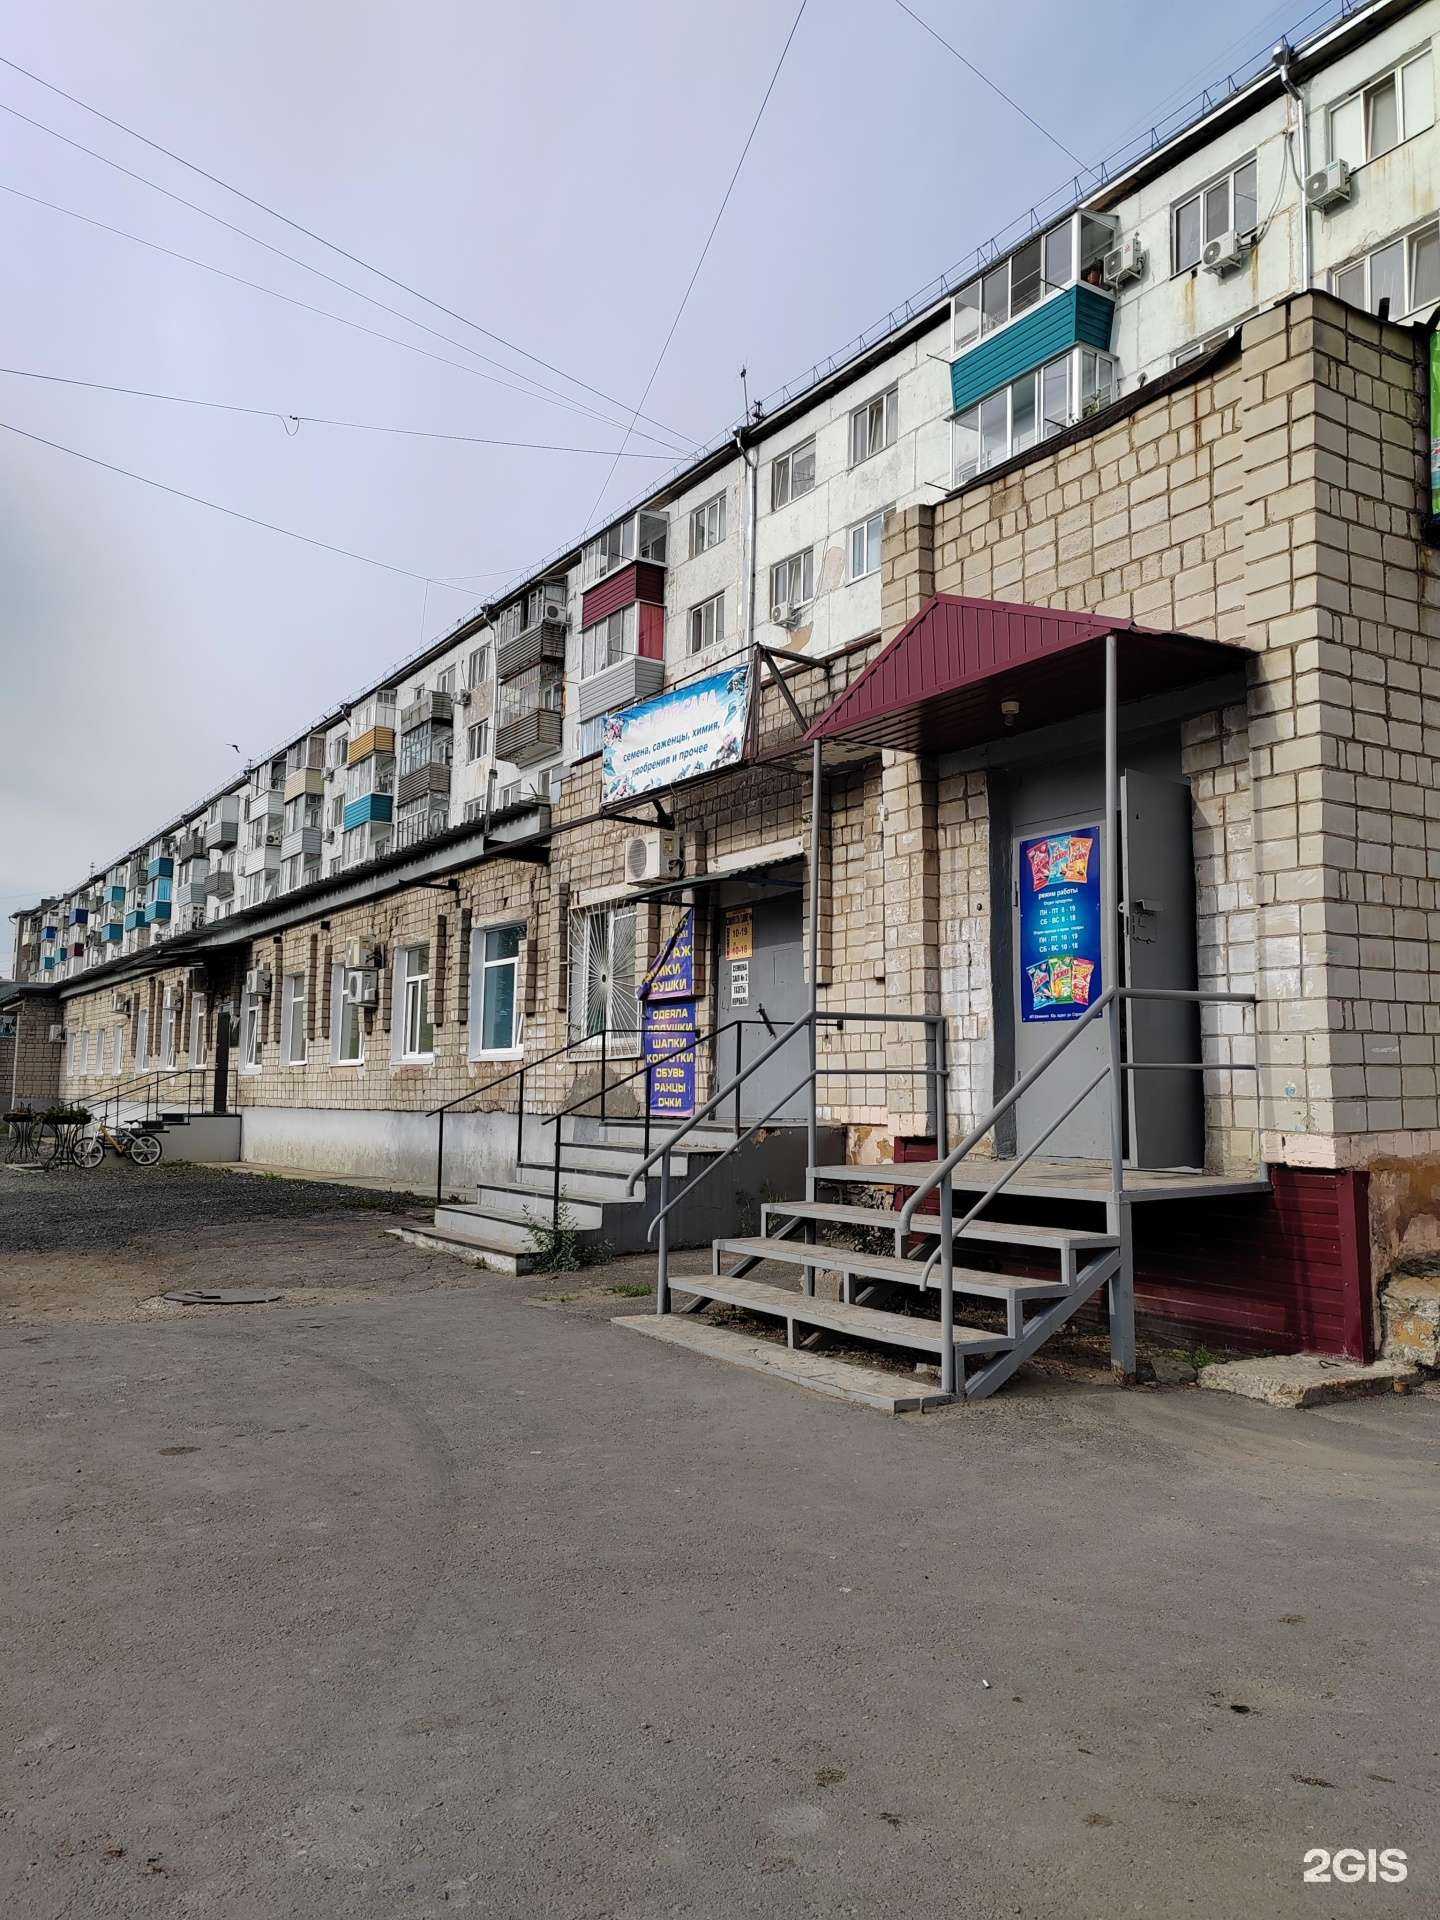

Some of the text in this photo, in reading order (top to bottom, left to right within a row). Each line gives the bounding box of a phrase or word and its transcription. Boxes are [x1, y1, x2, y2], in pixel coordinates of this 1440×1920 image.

[692, 720, 720, 737] химия,
[679, 743, 709, 760] прочее
[1057, 888, 1079, 897] работы
[1051, 907, 1059, 915] ПТ
[651, 979, 687, 993] РУШКИ
[652, 1008, 688, 1020] ОДЕЯЛА
[652, 1038, 686, 1049] ШАПКИ
[656, 1067, 684, 1078] ОБУВЬ
[654, 1082, 686, 1094] РАНЦЫ
[658, 1097, 681, 1107] ОЧКИ
